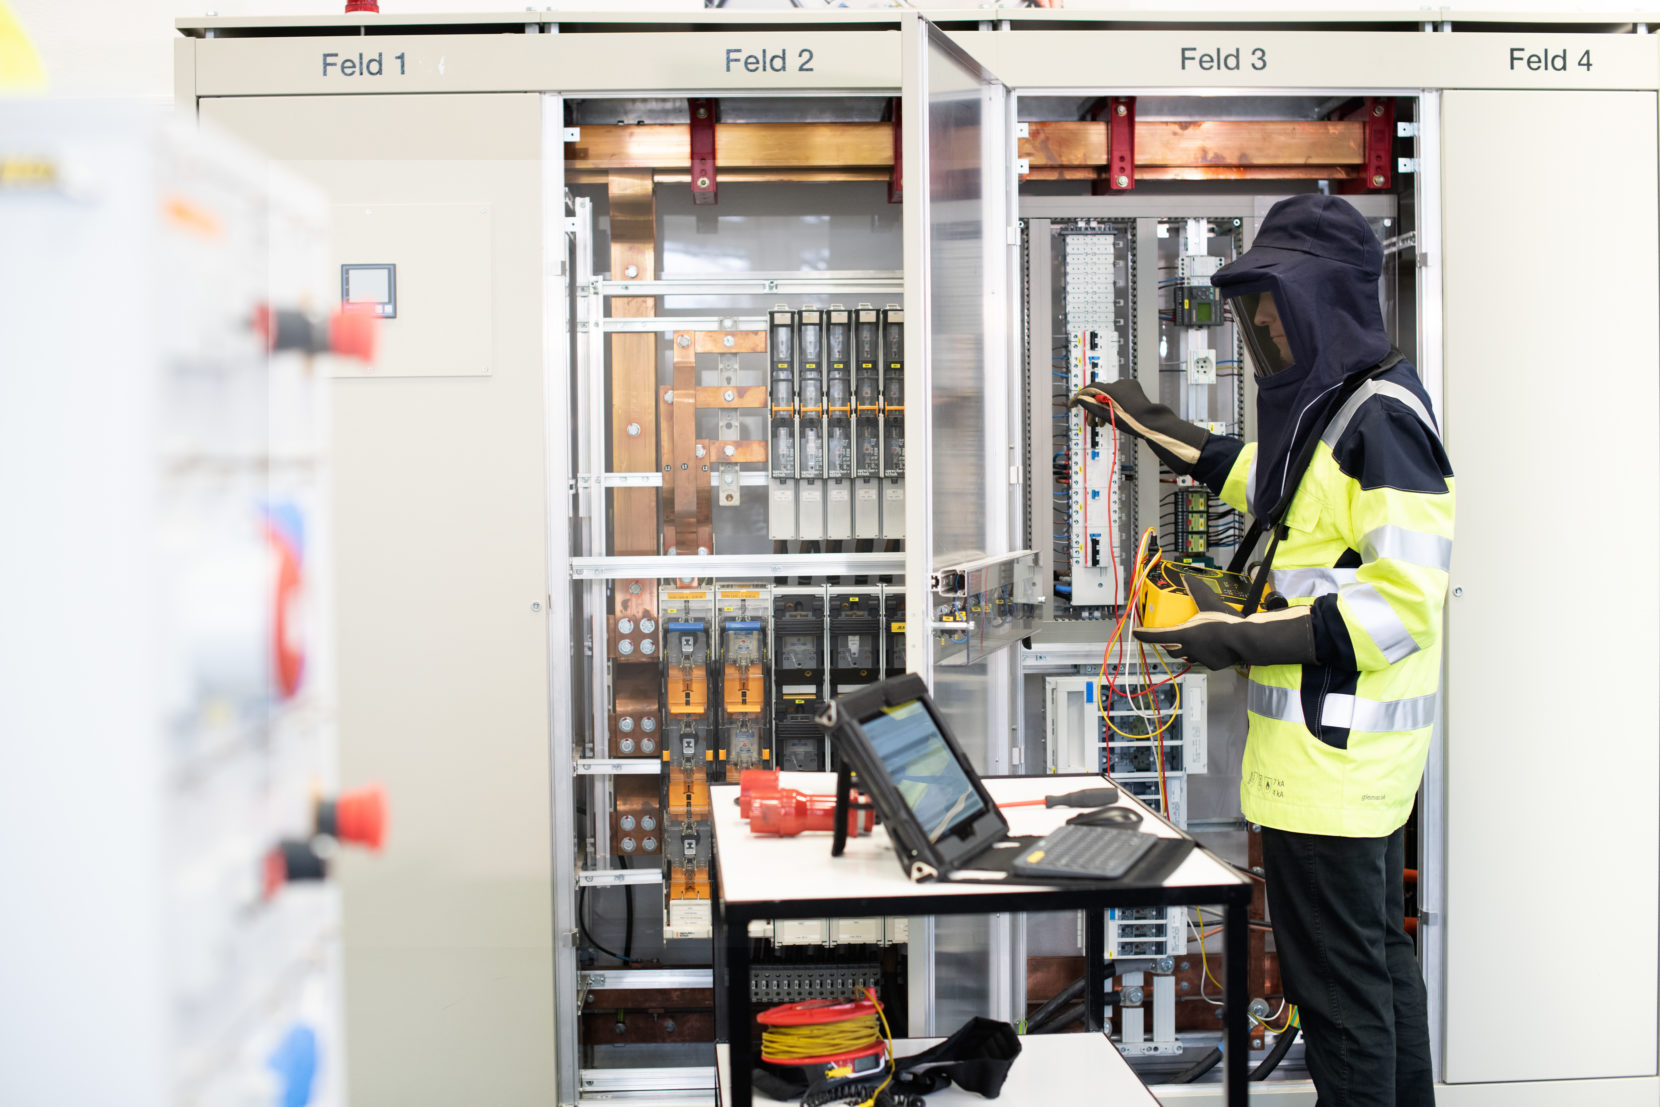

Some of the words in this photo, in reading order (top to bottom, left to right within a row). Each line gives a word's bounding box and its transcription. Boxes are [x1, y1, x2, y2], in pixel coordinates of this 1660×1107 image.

[322, 52, 383, 77] Feld
[395, 52, 405, 75] 1
[725, 48, 787, 73] Feld
[798, 48, 814, 72] 2
[1181, 47, 1240, 71] Feld
[1251, 47, 1267, 71] 3
[1509, 47, 1567, 72] Feld
[1577, 49, 1593, 72] 4
